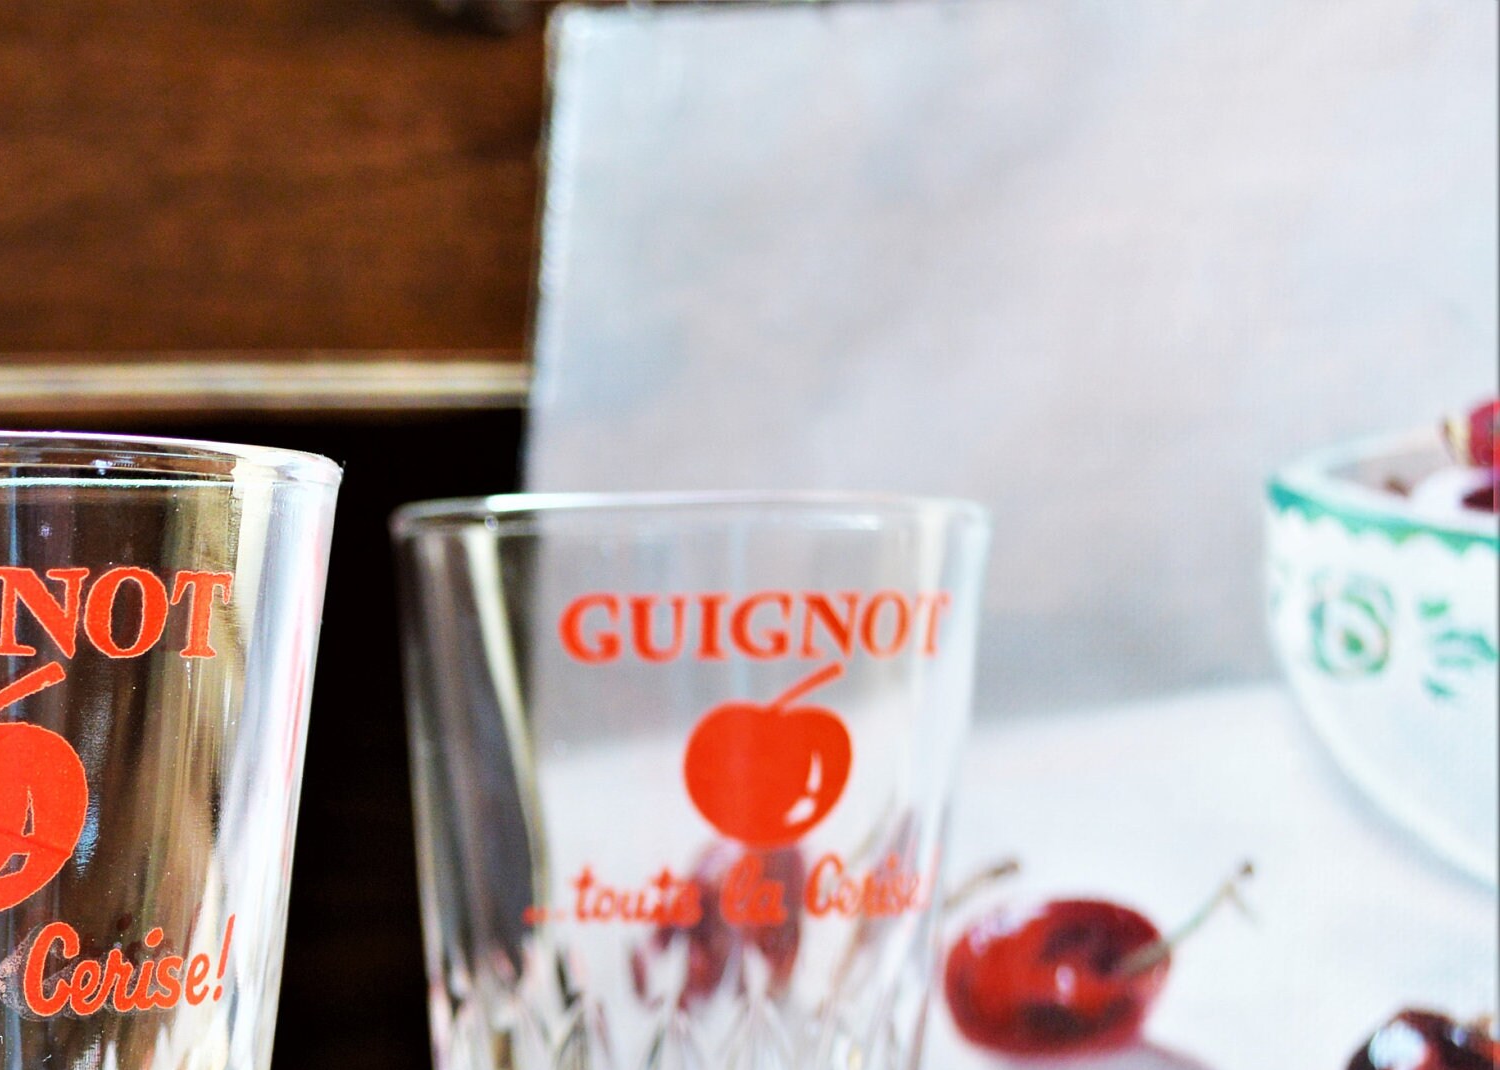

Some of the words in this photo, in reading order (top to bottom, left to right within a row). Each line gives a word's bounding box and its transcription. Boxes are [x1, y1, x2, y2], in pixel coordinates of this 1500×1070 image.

[558, 590, 949, 664] GUIGNOT
[719, 852, 787, 927] la
[23, 912, 236, 1017] Cerise!
